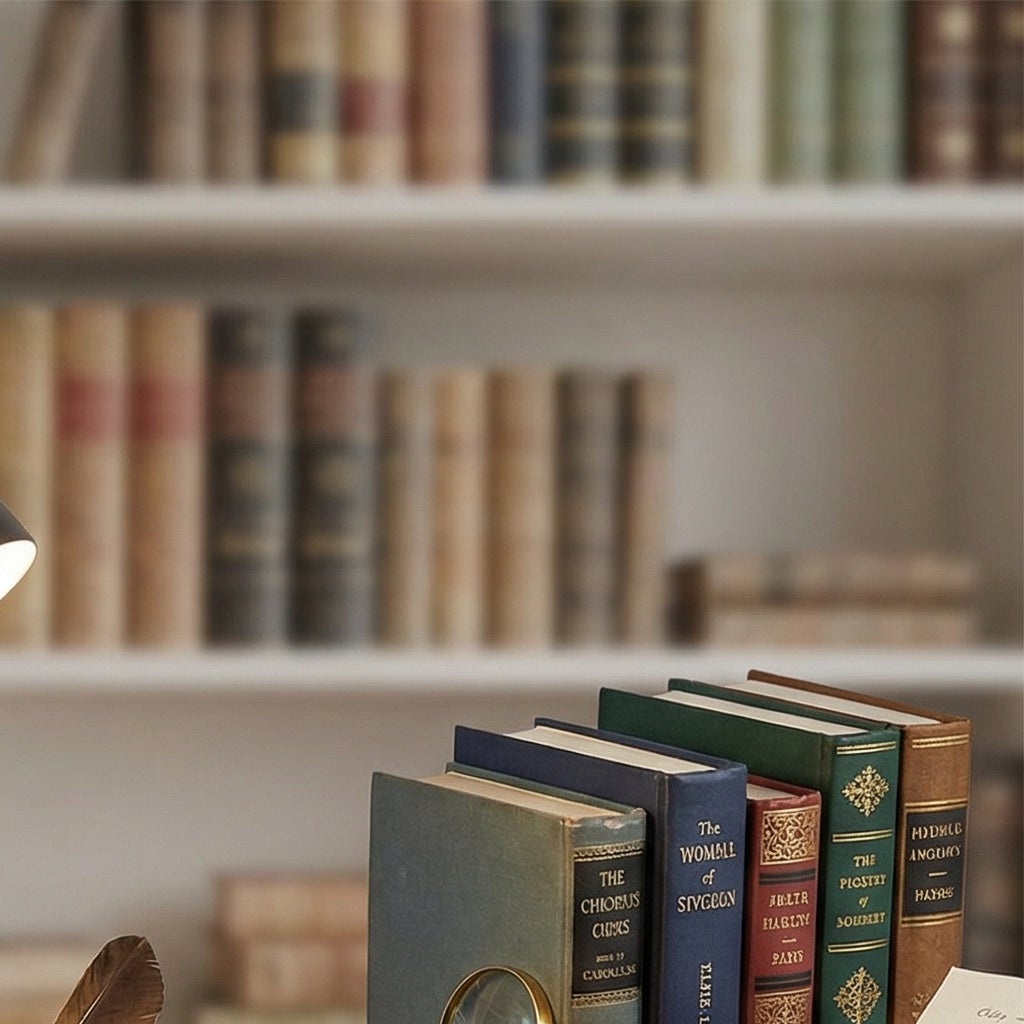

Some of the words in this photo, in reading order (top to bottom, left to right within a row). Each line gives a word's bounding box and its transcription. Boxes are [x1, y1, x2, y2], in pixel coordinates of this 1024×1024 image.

[698, 821, 721, 836] The
[853, 854, 876, 868] THE
[599, 869, 625, 887] THE
[702, 869, 716, 885] of
